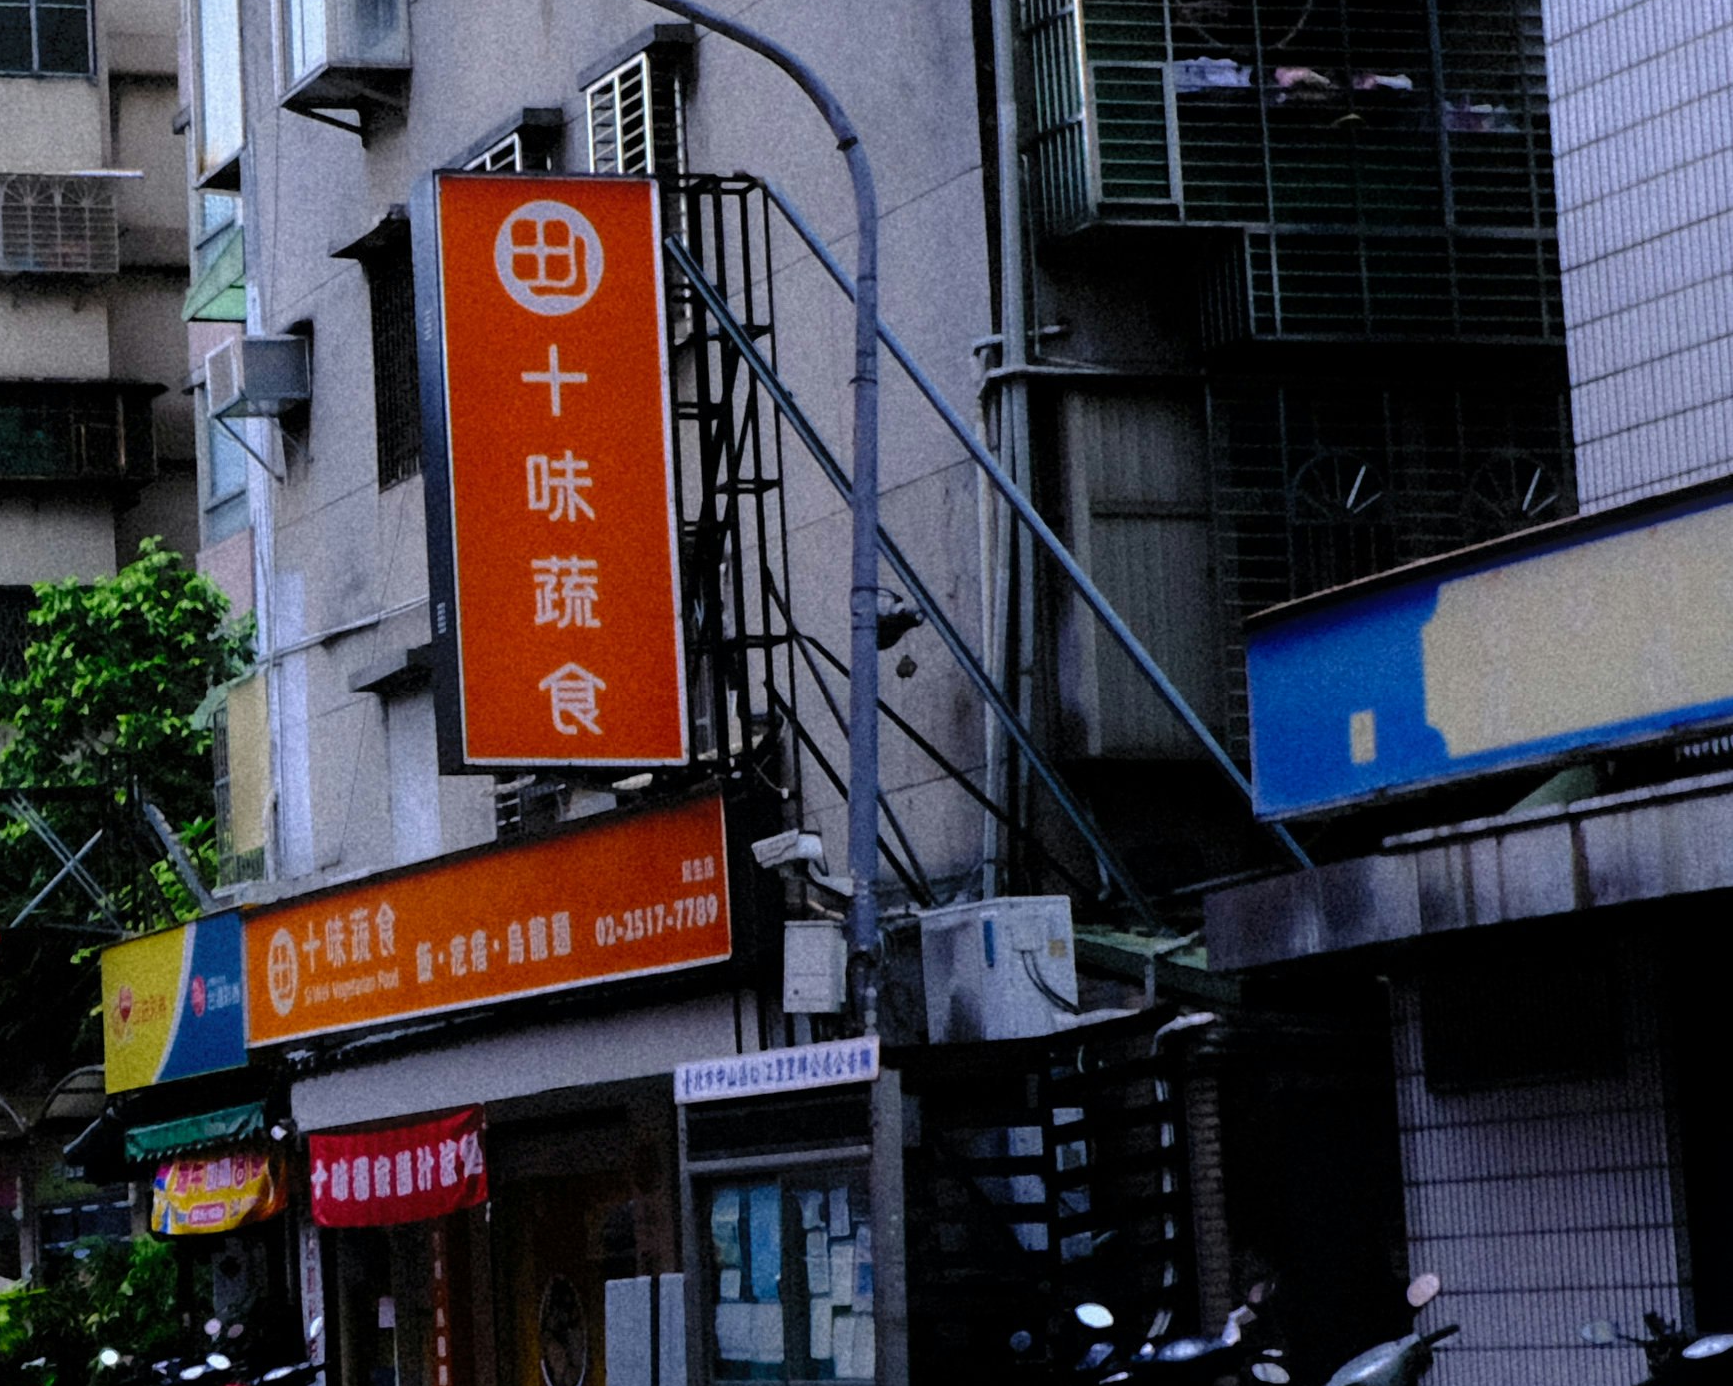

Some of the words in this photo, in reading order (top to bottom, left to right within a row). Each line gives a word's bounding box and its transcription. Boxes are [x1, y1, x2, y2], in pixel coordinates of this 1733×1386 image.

[520, 345, 607, 737] 十味蔬食
[302, 902, 396, 973] 十味蔬食
[595, 893, 718, 948] 02-2517-7789
